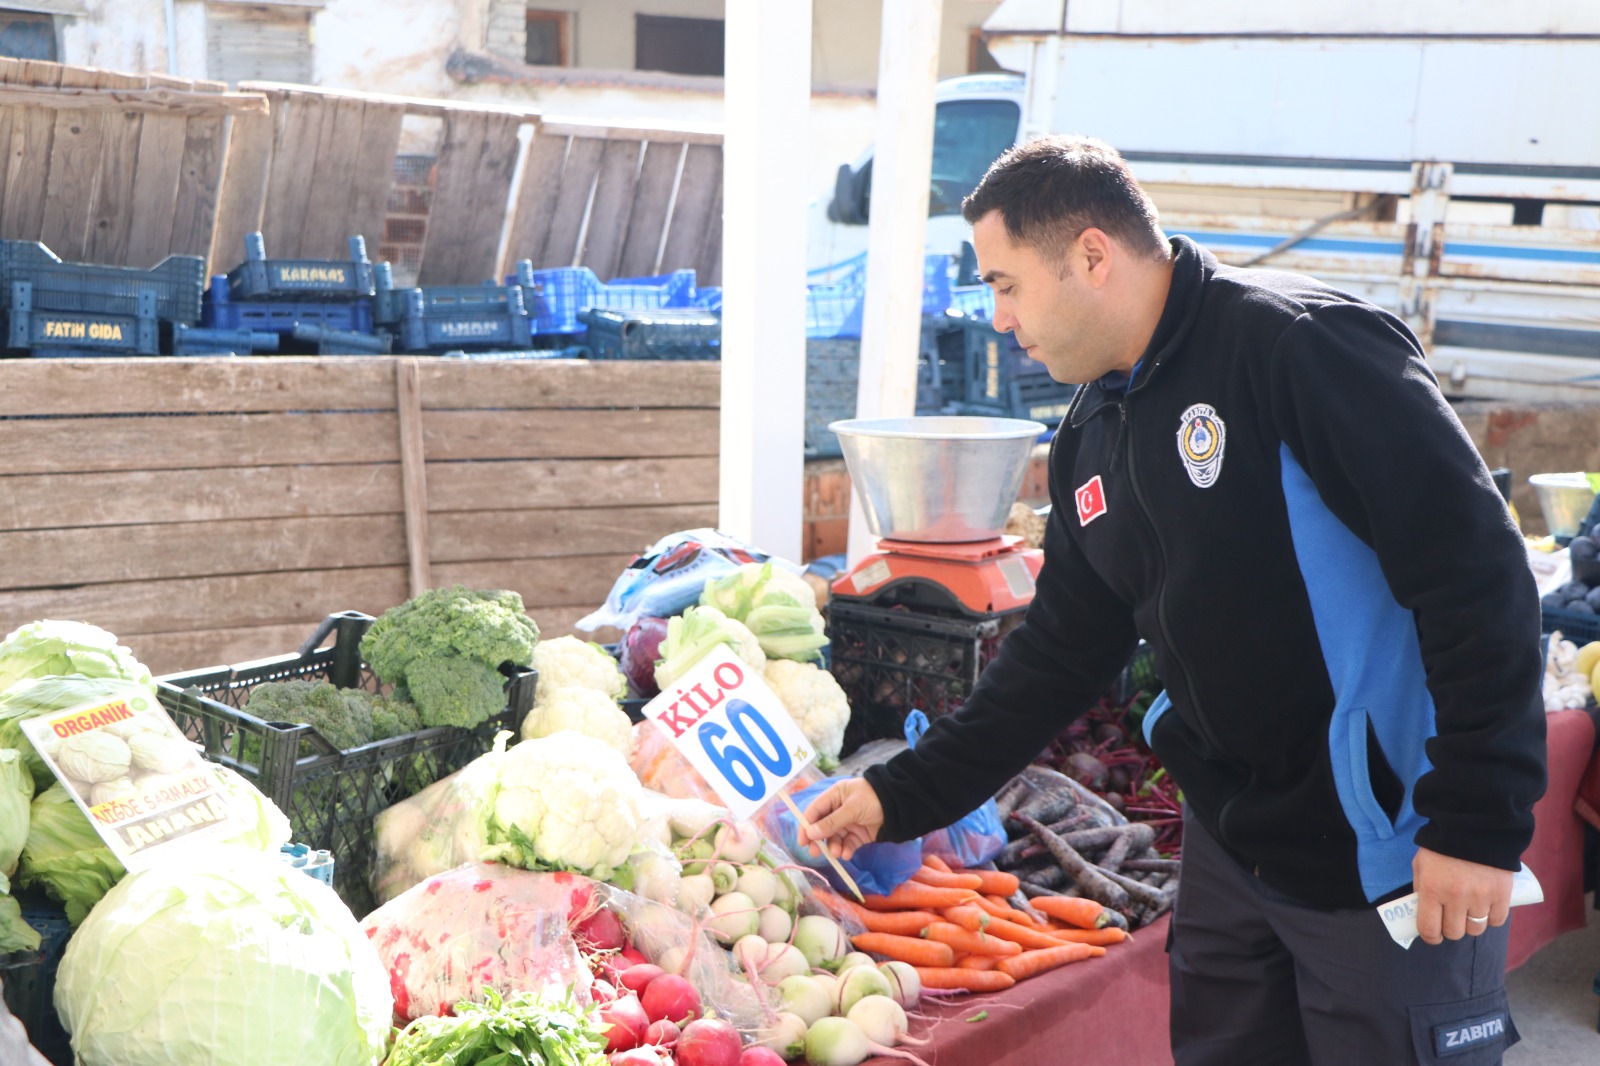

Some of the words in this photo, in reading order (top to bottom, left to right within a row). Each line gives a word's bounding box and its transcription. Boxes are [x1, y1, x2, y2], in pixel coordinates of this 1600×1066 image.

[89, 323, 122, 340] GIDA
[53, 703, 134, 738] ORGANİK
[656, 662, 744, 738] KİLO
[698, 698, 792, 801] 60
[92, 800, 144, 825] NİĞDE
[144, 776, 214, 810] SARMALIK
[112, 793, 230, 856] LAHANA
[1445, 1018, 1504, 1047] ZABITA
